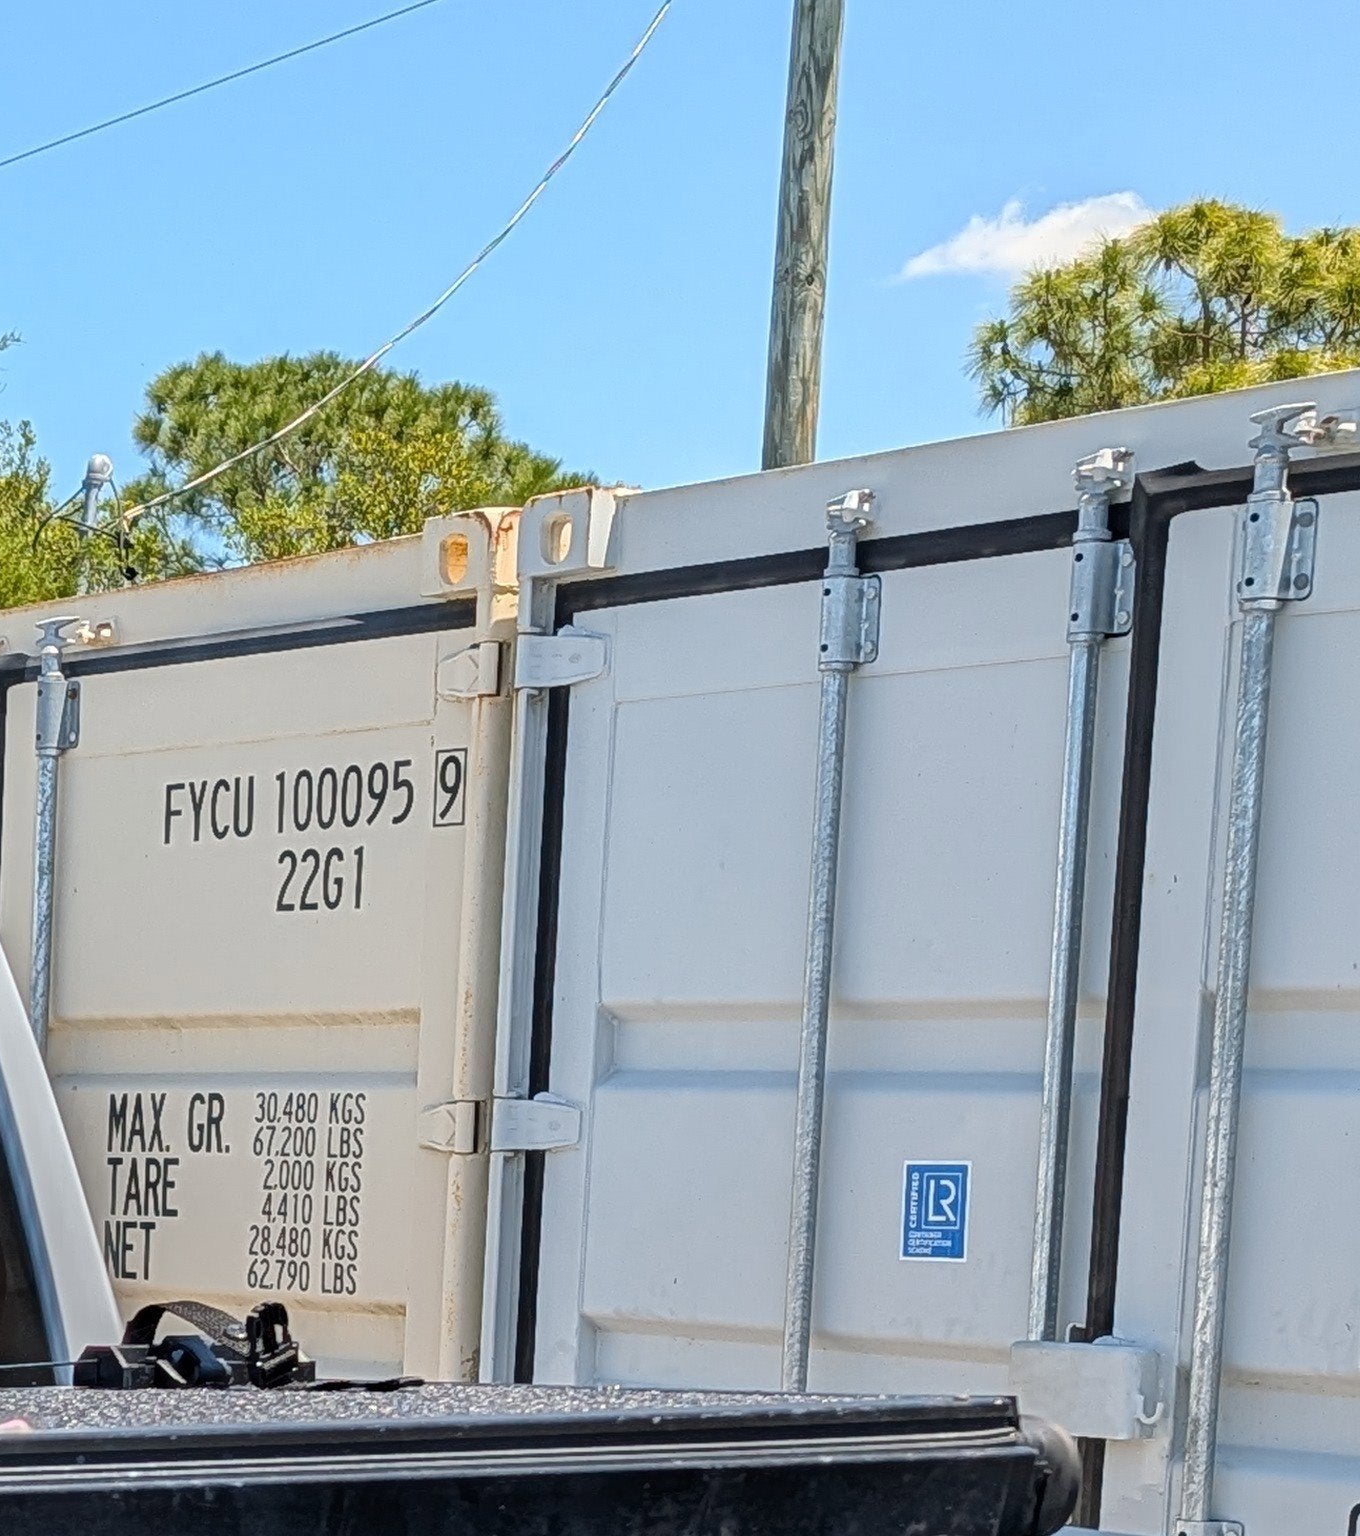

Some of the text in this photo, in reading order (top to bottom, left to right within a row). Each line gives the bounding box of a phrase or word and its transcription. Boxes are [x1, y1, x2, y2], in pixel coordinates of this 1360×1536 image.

[163, 753, 464, 844] FYCU 100095 9
[276, 845, 364, 912] 22G1
[107, 1091, 170, 1153] MAX.
[187, 1092, 231, 1154] GR.
[329, 1092, 367, 1125] KGS
[327, 1127, 365, 1159] LBS
[107, 1156, 180, 1218] TARE
[325, 1161, 363, 1192] KGS
[323, 1196, 361, 1228] LBS
[927, 1179, 957, 1222] LR
[104, 1220, 156, 1280] NET
[321, 1227, 360, 1261] KGS
[321, 1262, 357, 1296] LBS
